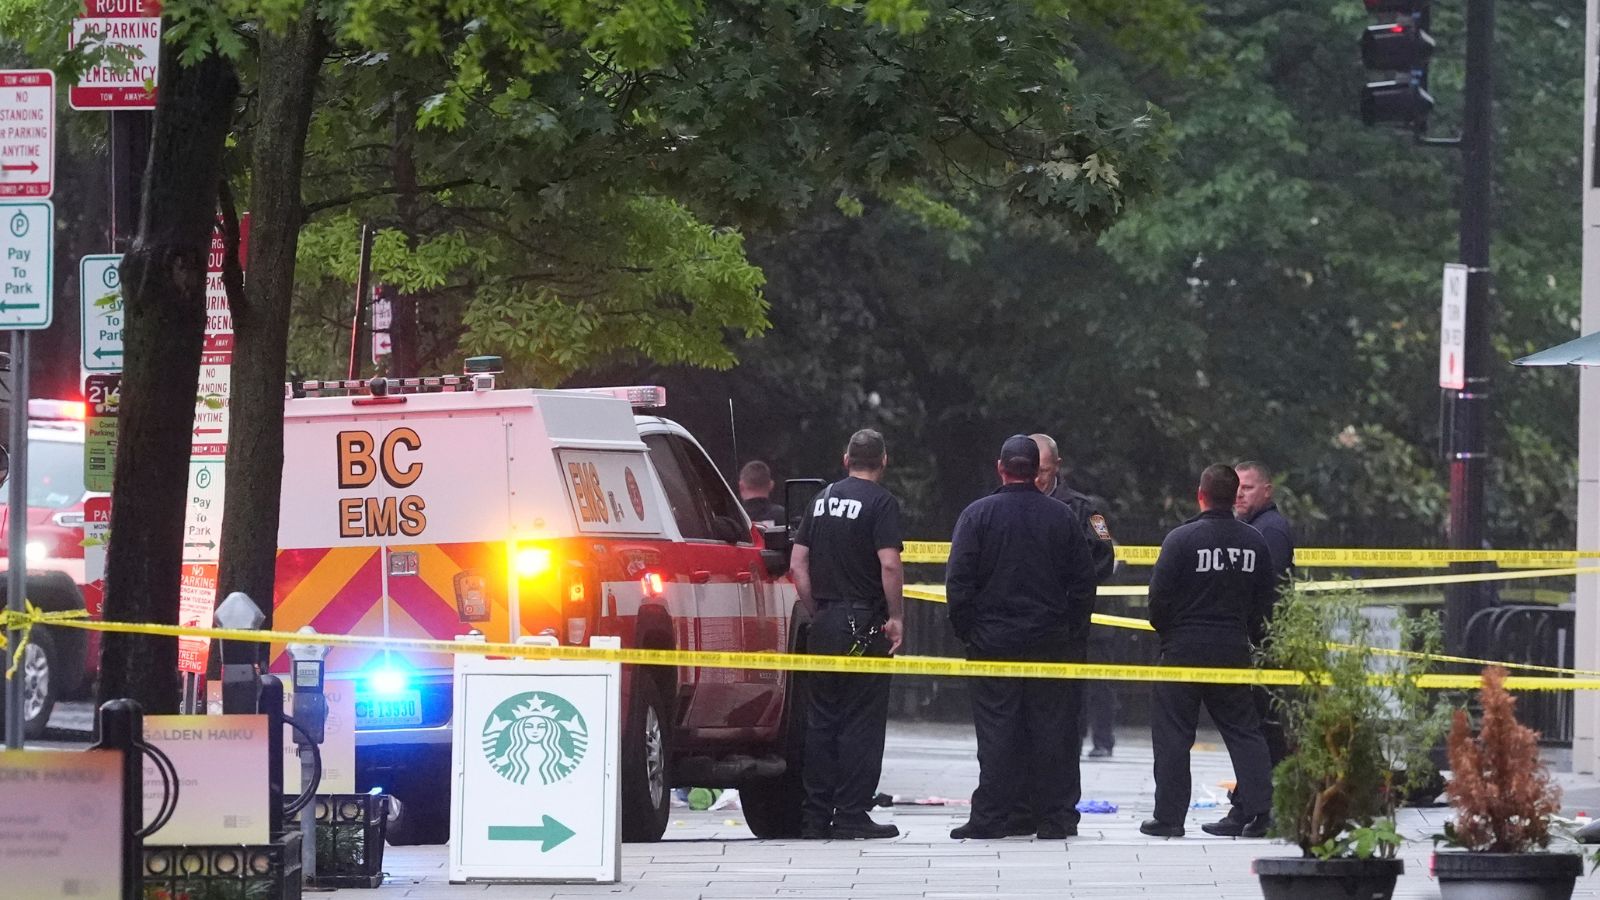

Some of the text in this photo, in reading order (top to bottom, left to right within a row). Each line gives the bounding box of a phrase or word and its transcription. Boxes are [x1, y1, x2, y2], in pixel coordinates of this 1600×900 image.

[105, 23, 157, 38] PARKING
[16, 91, 28, 103] NO
[100, 93, 141, 101] TOW AWAY
[0, 109, 43, 121] STANDING
[8, 127, 47, 139] PARKING
[2, 144, 40, 157] ANYTIME
[8, 248, 31, 261] Pay
[12, 267, 27, 278] To
[5, 283, 33, 295] Park
[106, 316, 119, 326] To
[206, 369, 216, 378] NO
[336, 427, 424, 490] BC
[568, 462, 609, 525] EMS
[193, 497, 211, 509] Pay
[339, 495, 427, 538] EMS
[189, 526, 211, 536] Park
[1123, 548, 1139, 559] POLICE
[1320, 551, 1336, 561] CROSS
[1352, 551, 1368, 561] POLICE
[1195, 547, 1256, 573] DCFD
[192, 566, 204, 577] NO
[208, 729, 254, 740] HAIKU
